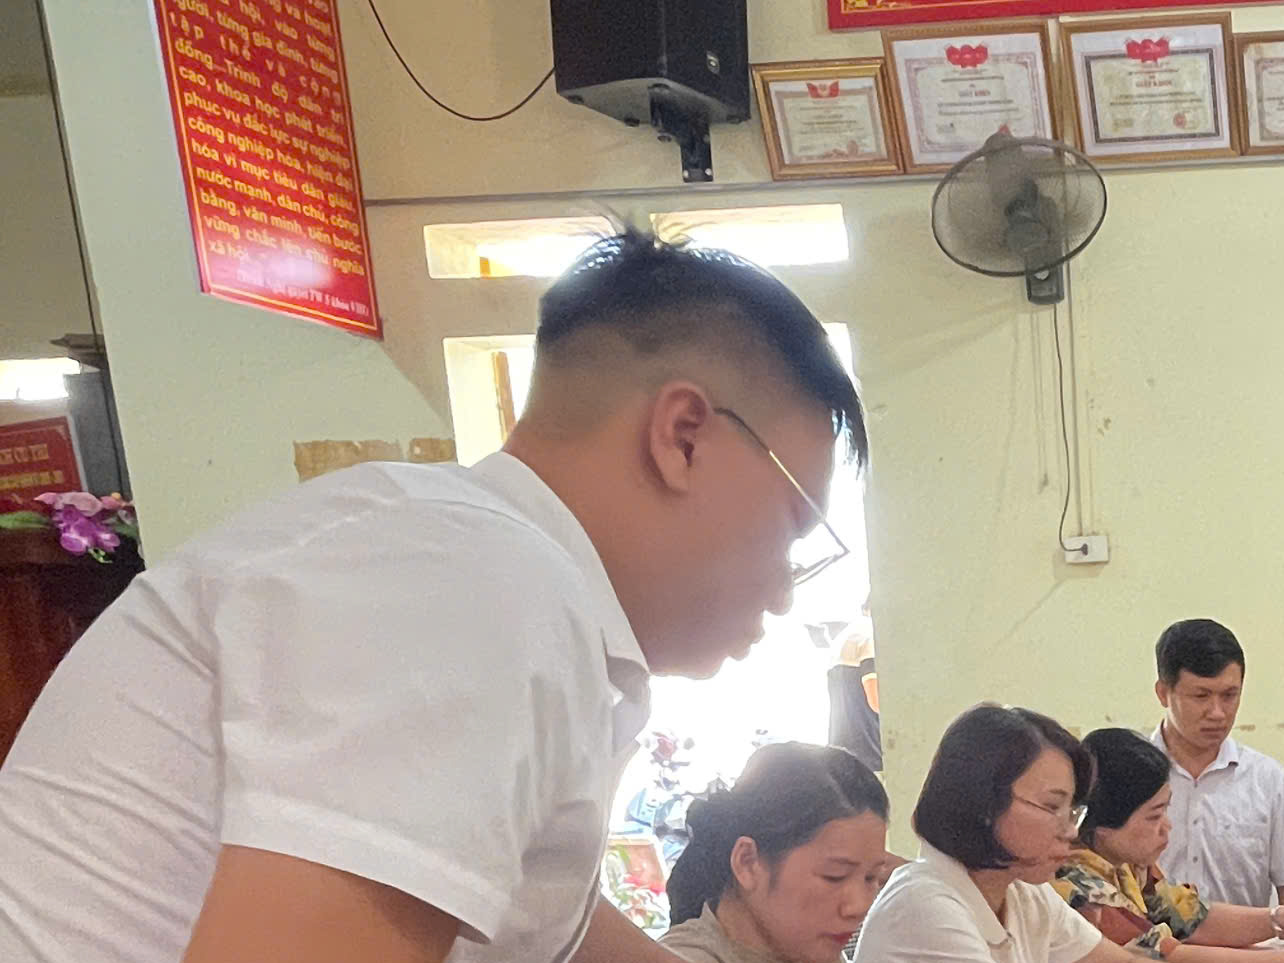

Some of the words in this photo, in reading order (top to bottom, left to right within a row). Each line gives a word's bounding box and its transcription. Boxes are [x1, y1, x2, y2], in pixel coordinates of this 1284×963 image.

[179, 65, 211, 92] cao,
[215, 78, 250, 105] khoa
[254, 96, 281, 119] học
[222, 107, 241, 127] vụ
[191, 137, 219, 162] hóa
[240, 159, 270, 181] mục
[228, 130, 274, 160] nghiệp
